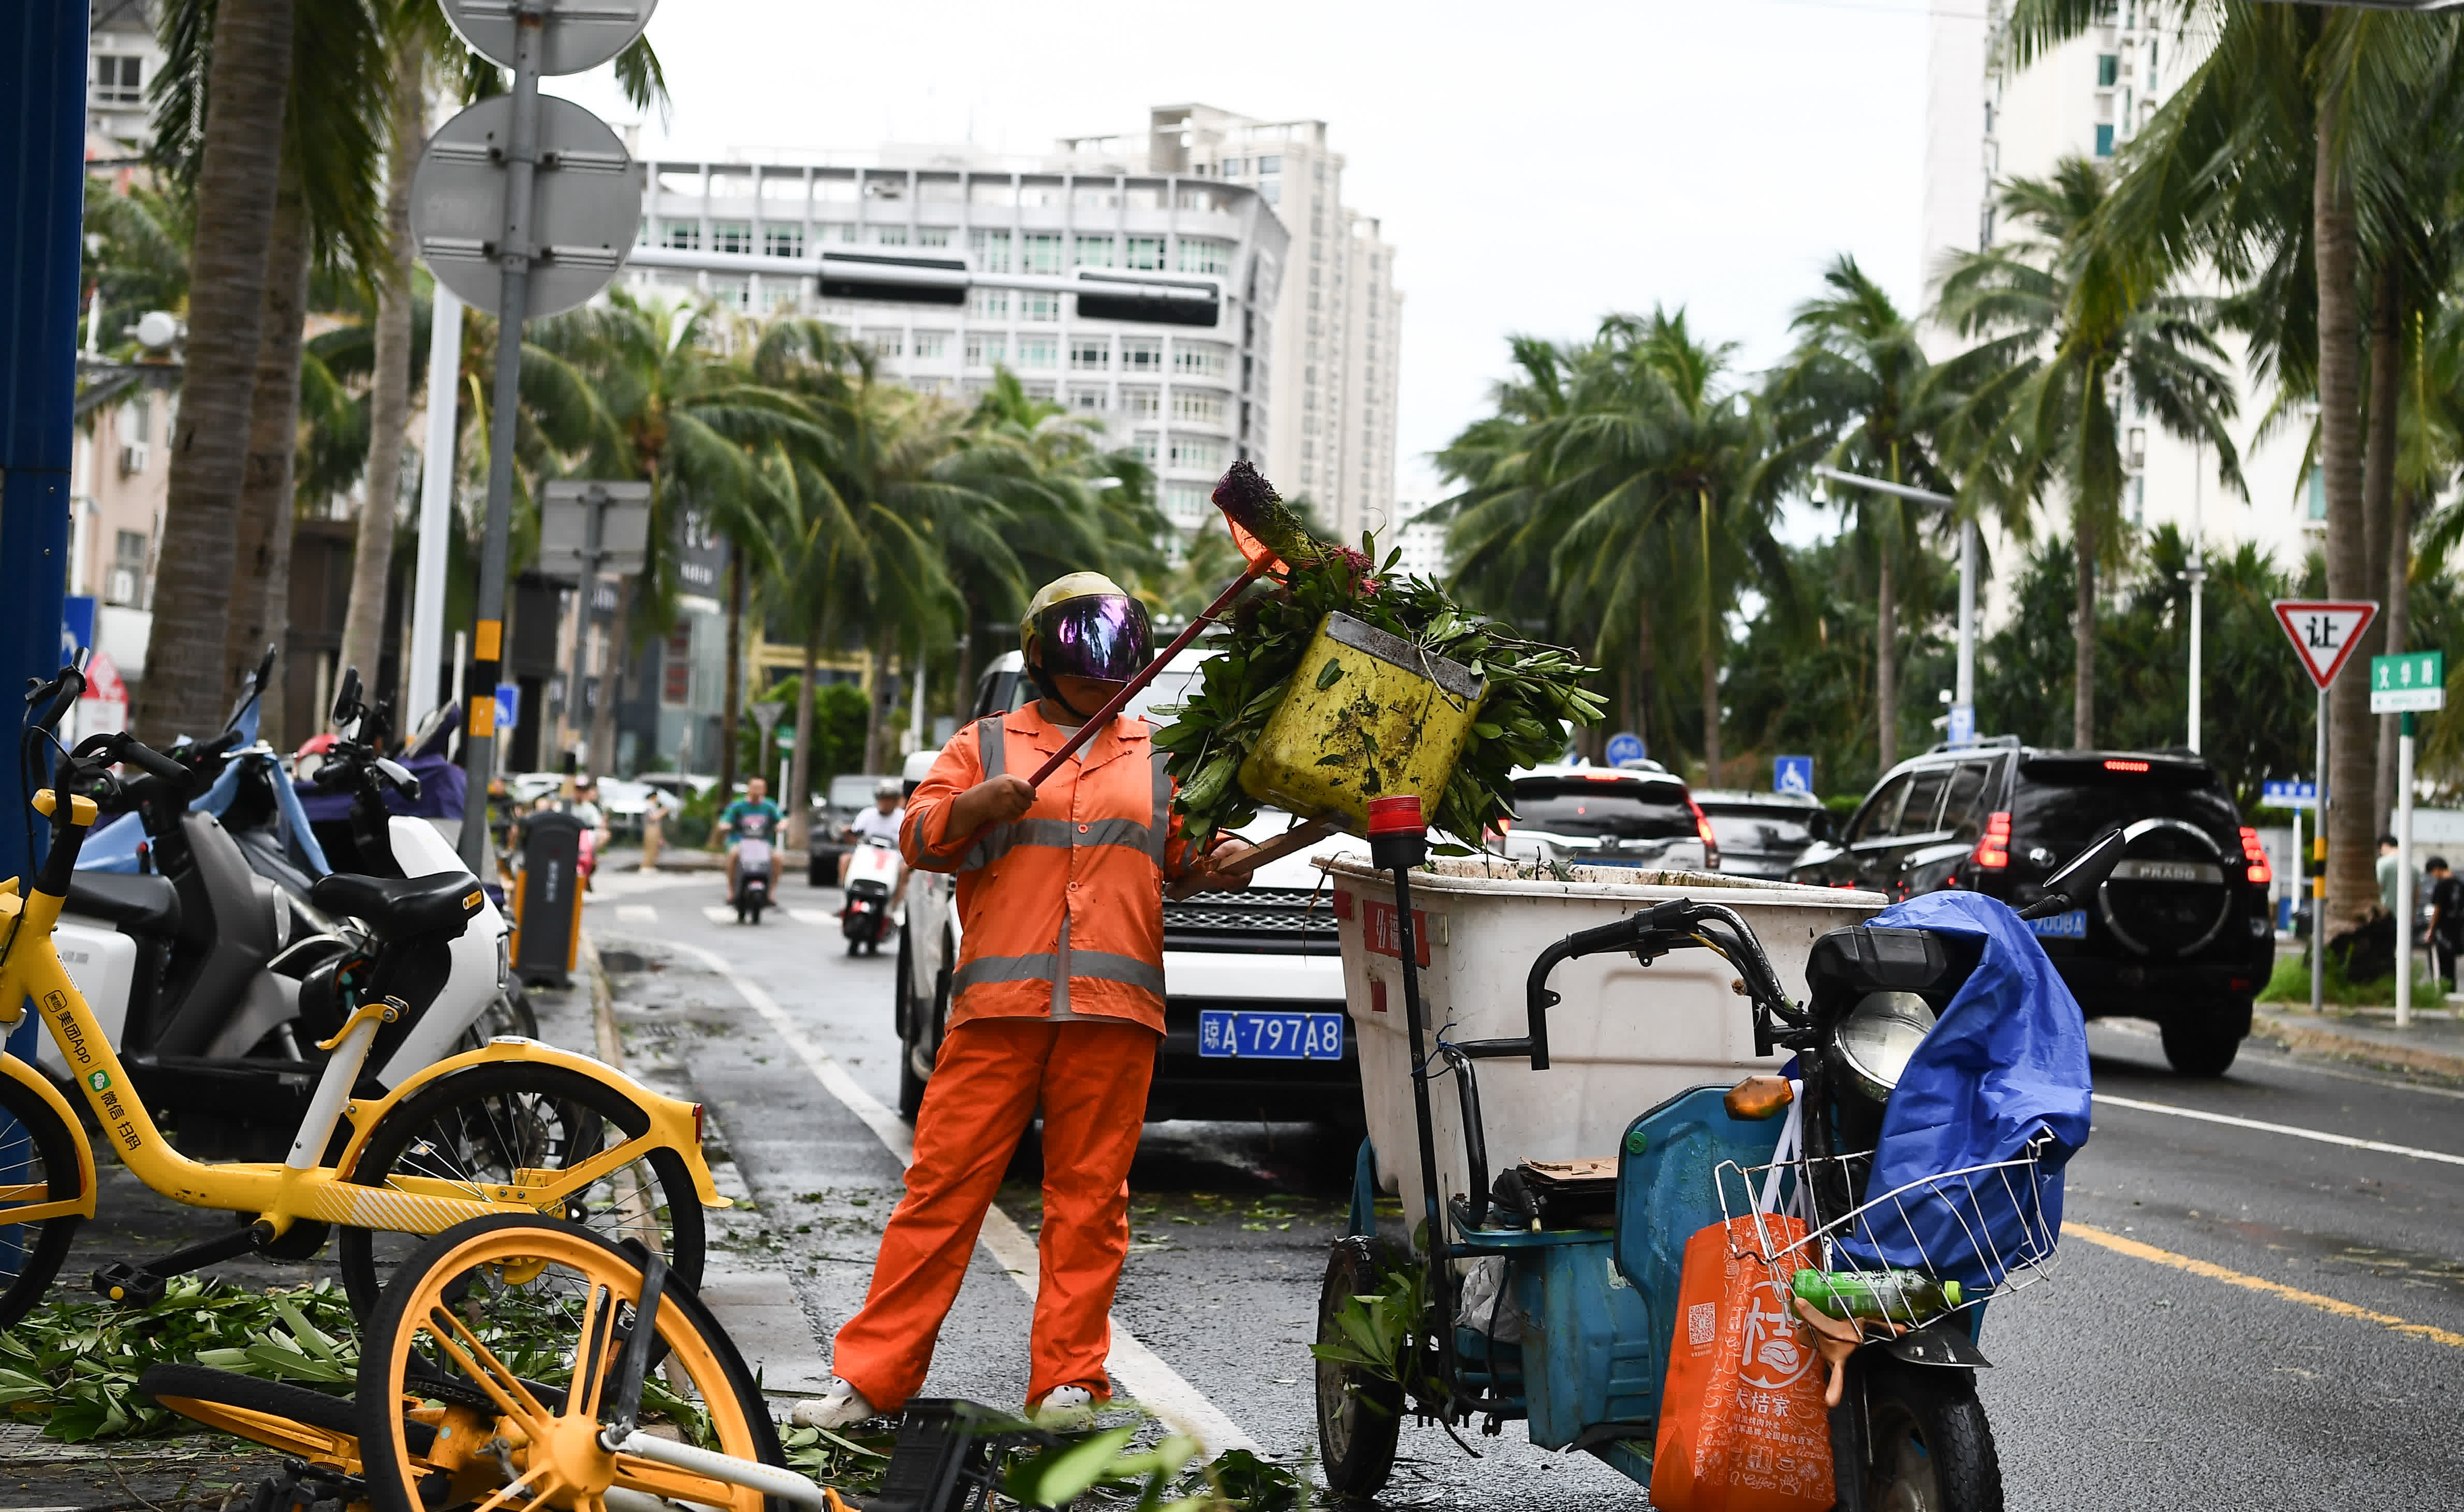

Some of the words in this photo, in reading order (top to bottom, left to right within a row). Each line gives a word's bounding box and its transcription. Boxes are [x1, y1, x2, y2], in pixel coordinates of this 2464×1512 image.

[2306, 615, 2339, 648] 让
[56, 1010, 91, 1064] 美团App
[100, 1091, 125, 1121] 微信
[117, 1121, 142, 1151] 扫码
